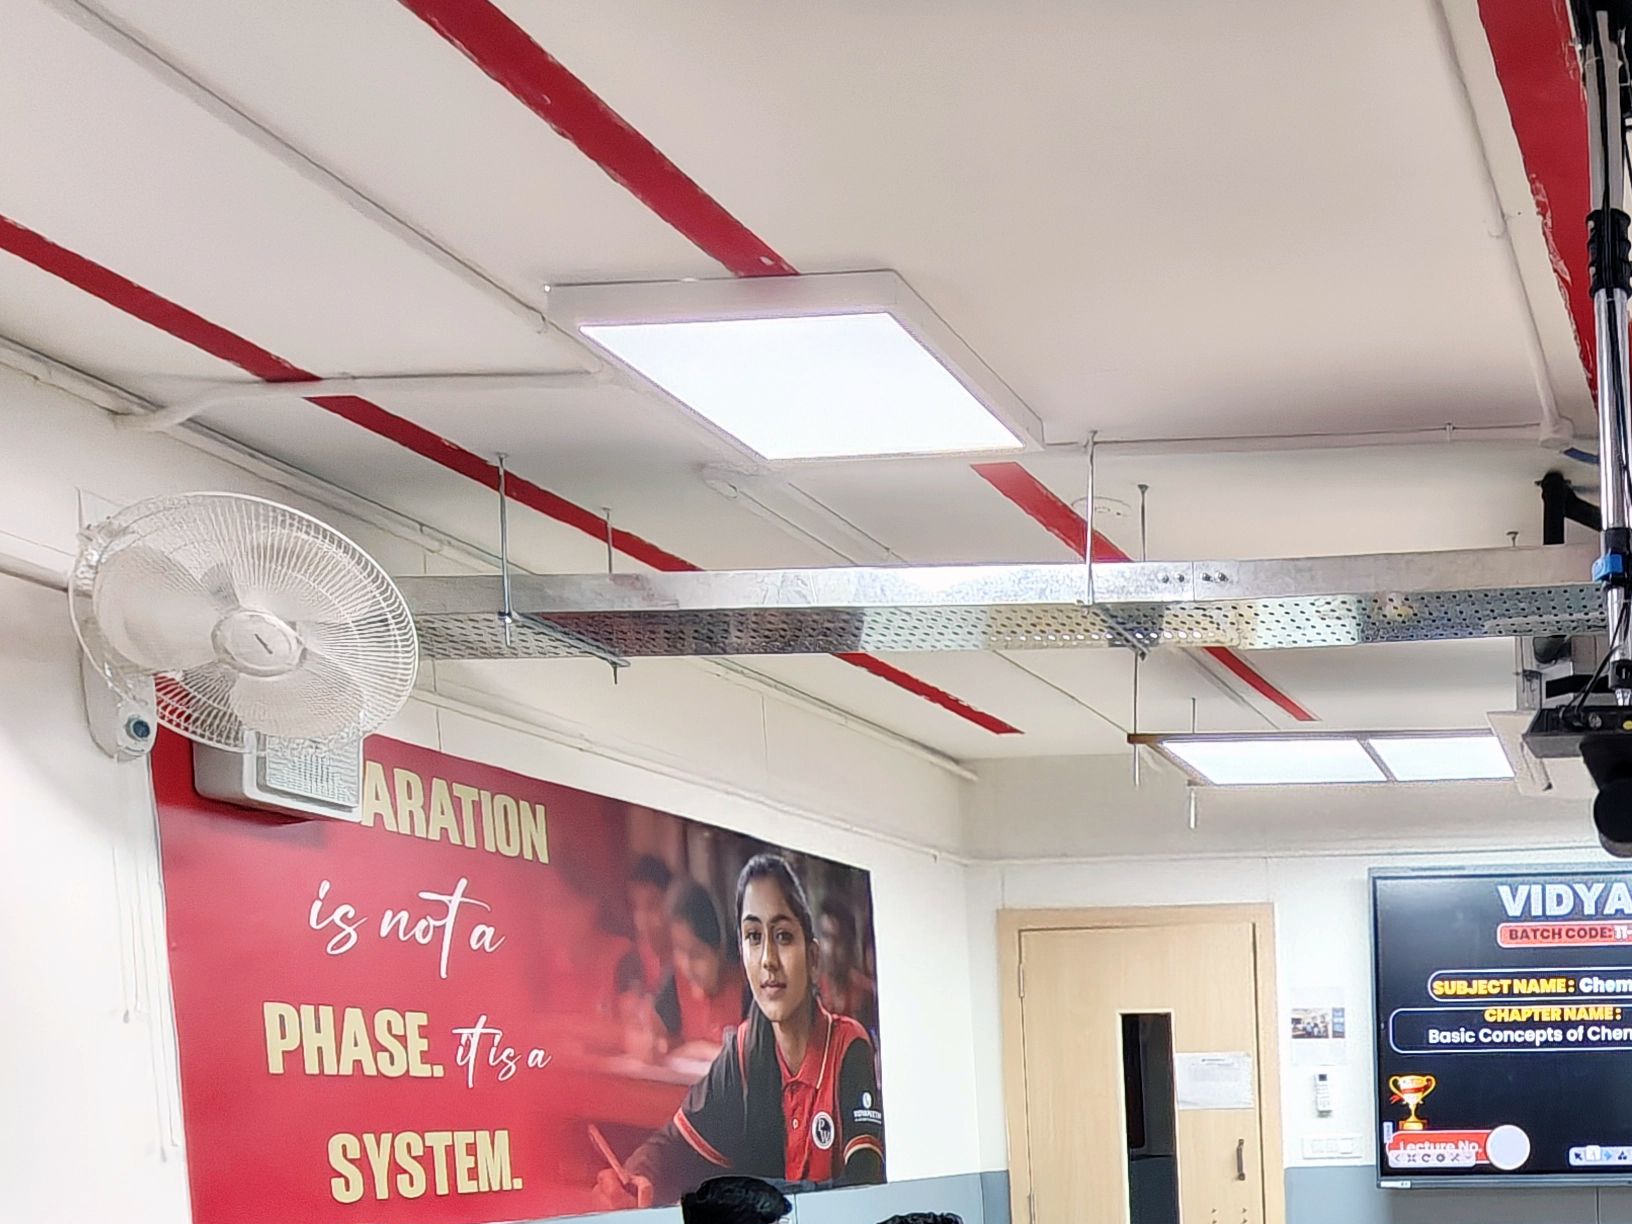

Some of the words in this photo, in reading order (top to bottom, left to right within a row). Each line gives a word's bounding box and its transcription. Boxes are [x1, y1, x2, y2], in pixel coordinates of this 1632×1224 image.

[360, 760, 549, 864] ARATION
[308, 880, 368, 955] is
[380, 877, 492, 979] not
[470, 924, 505, 953] a
[1508, 927, 1562, 941] BATCH
[1568, 926, 1613, 940] CODE:
[1432, 979, 1512, 996] SUBJECT
[1428, 1027, 1475, 1044] Basic
[1478, 1027, 1563, 1046] Concepts
[1566, 1026, 1584, 1042] of
[1484, 1007, 1562, 1022] CHAPTER
[263, 1001, 444, 1078] PHASE.
[452, 1014, 503, 1088] it
[488, 1033, 521, 1082] is
[527, 1048, 552, 1069] a
[327, 1129, 523, 1204] SYSTEM.
